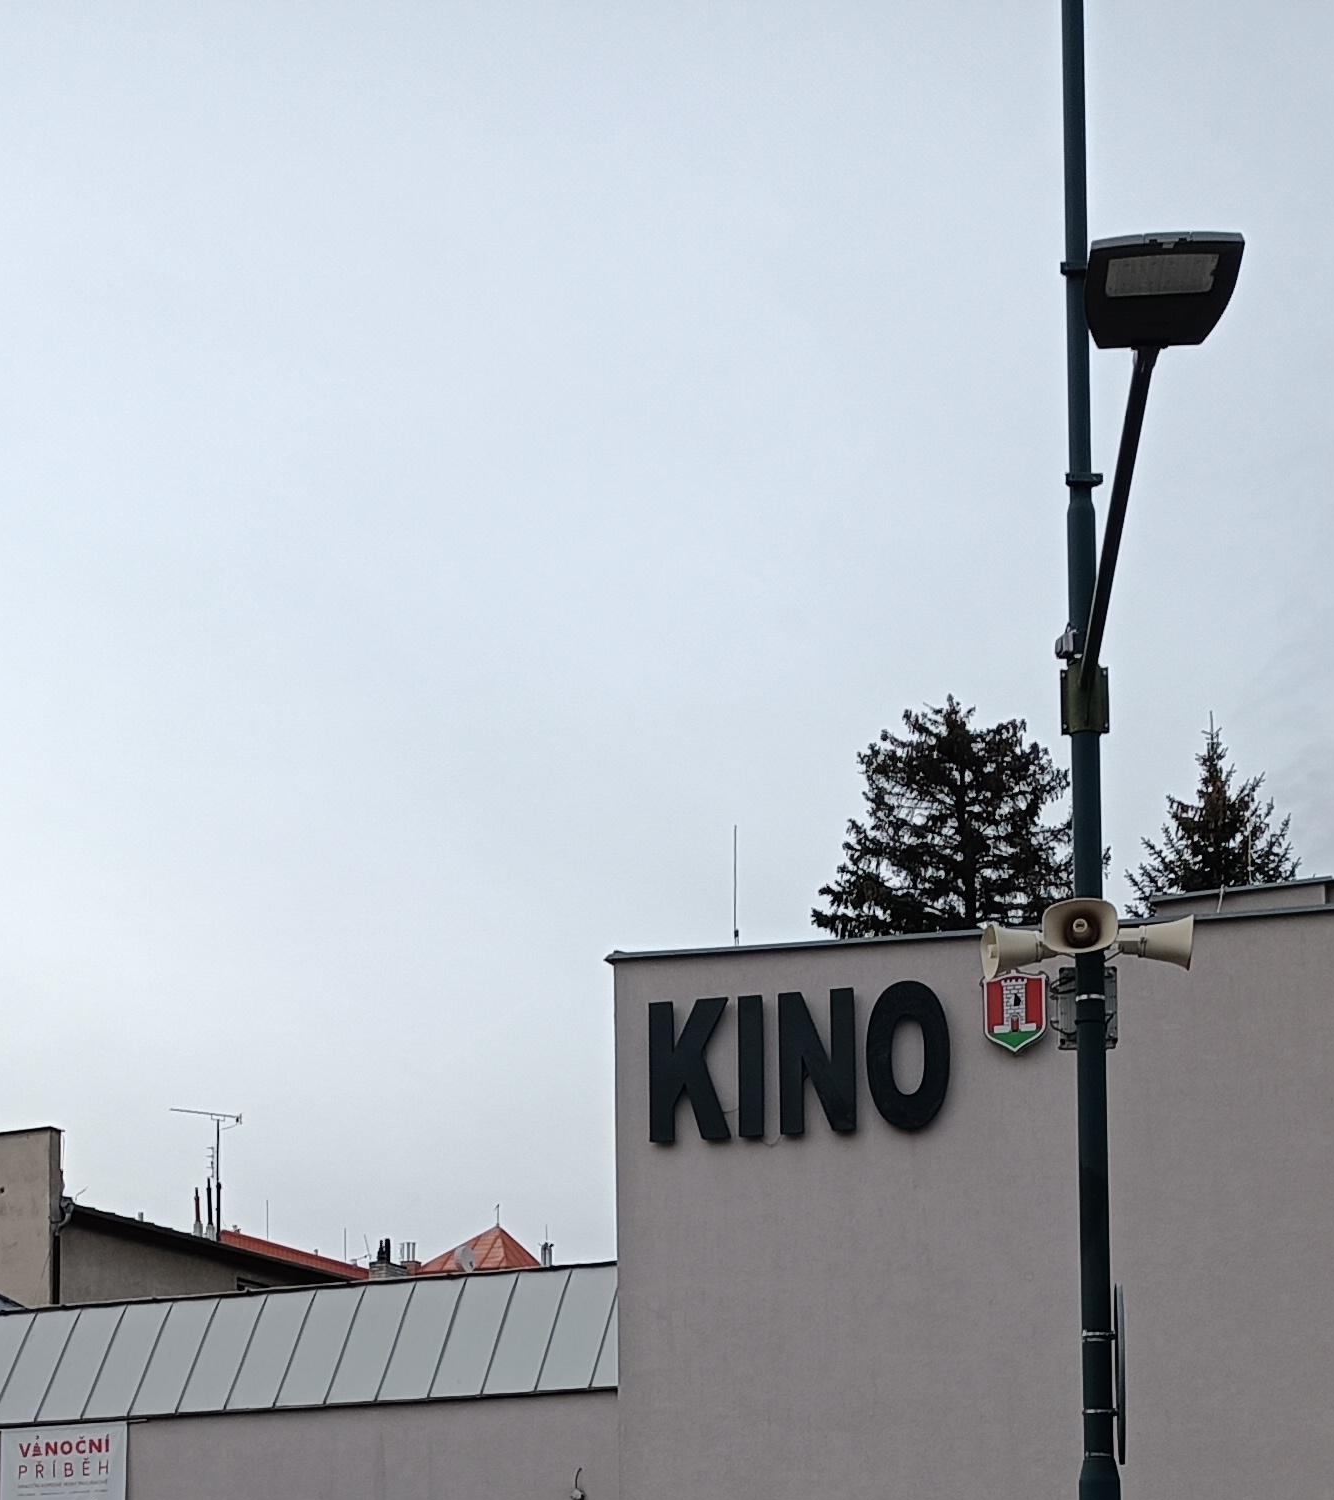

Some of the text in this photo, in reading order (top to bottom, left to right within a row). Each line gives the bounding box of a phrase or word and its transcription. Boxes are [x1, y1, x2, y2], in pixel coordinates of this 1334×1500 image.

[648, 979, 951, 1144] KINO
[18, 1433, 110, 1458] VÁNOČNÍ
[18, 1457, 109, 1480] PŘÍBĚH
